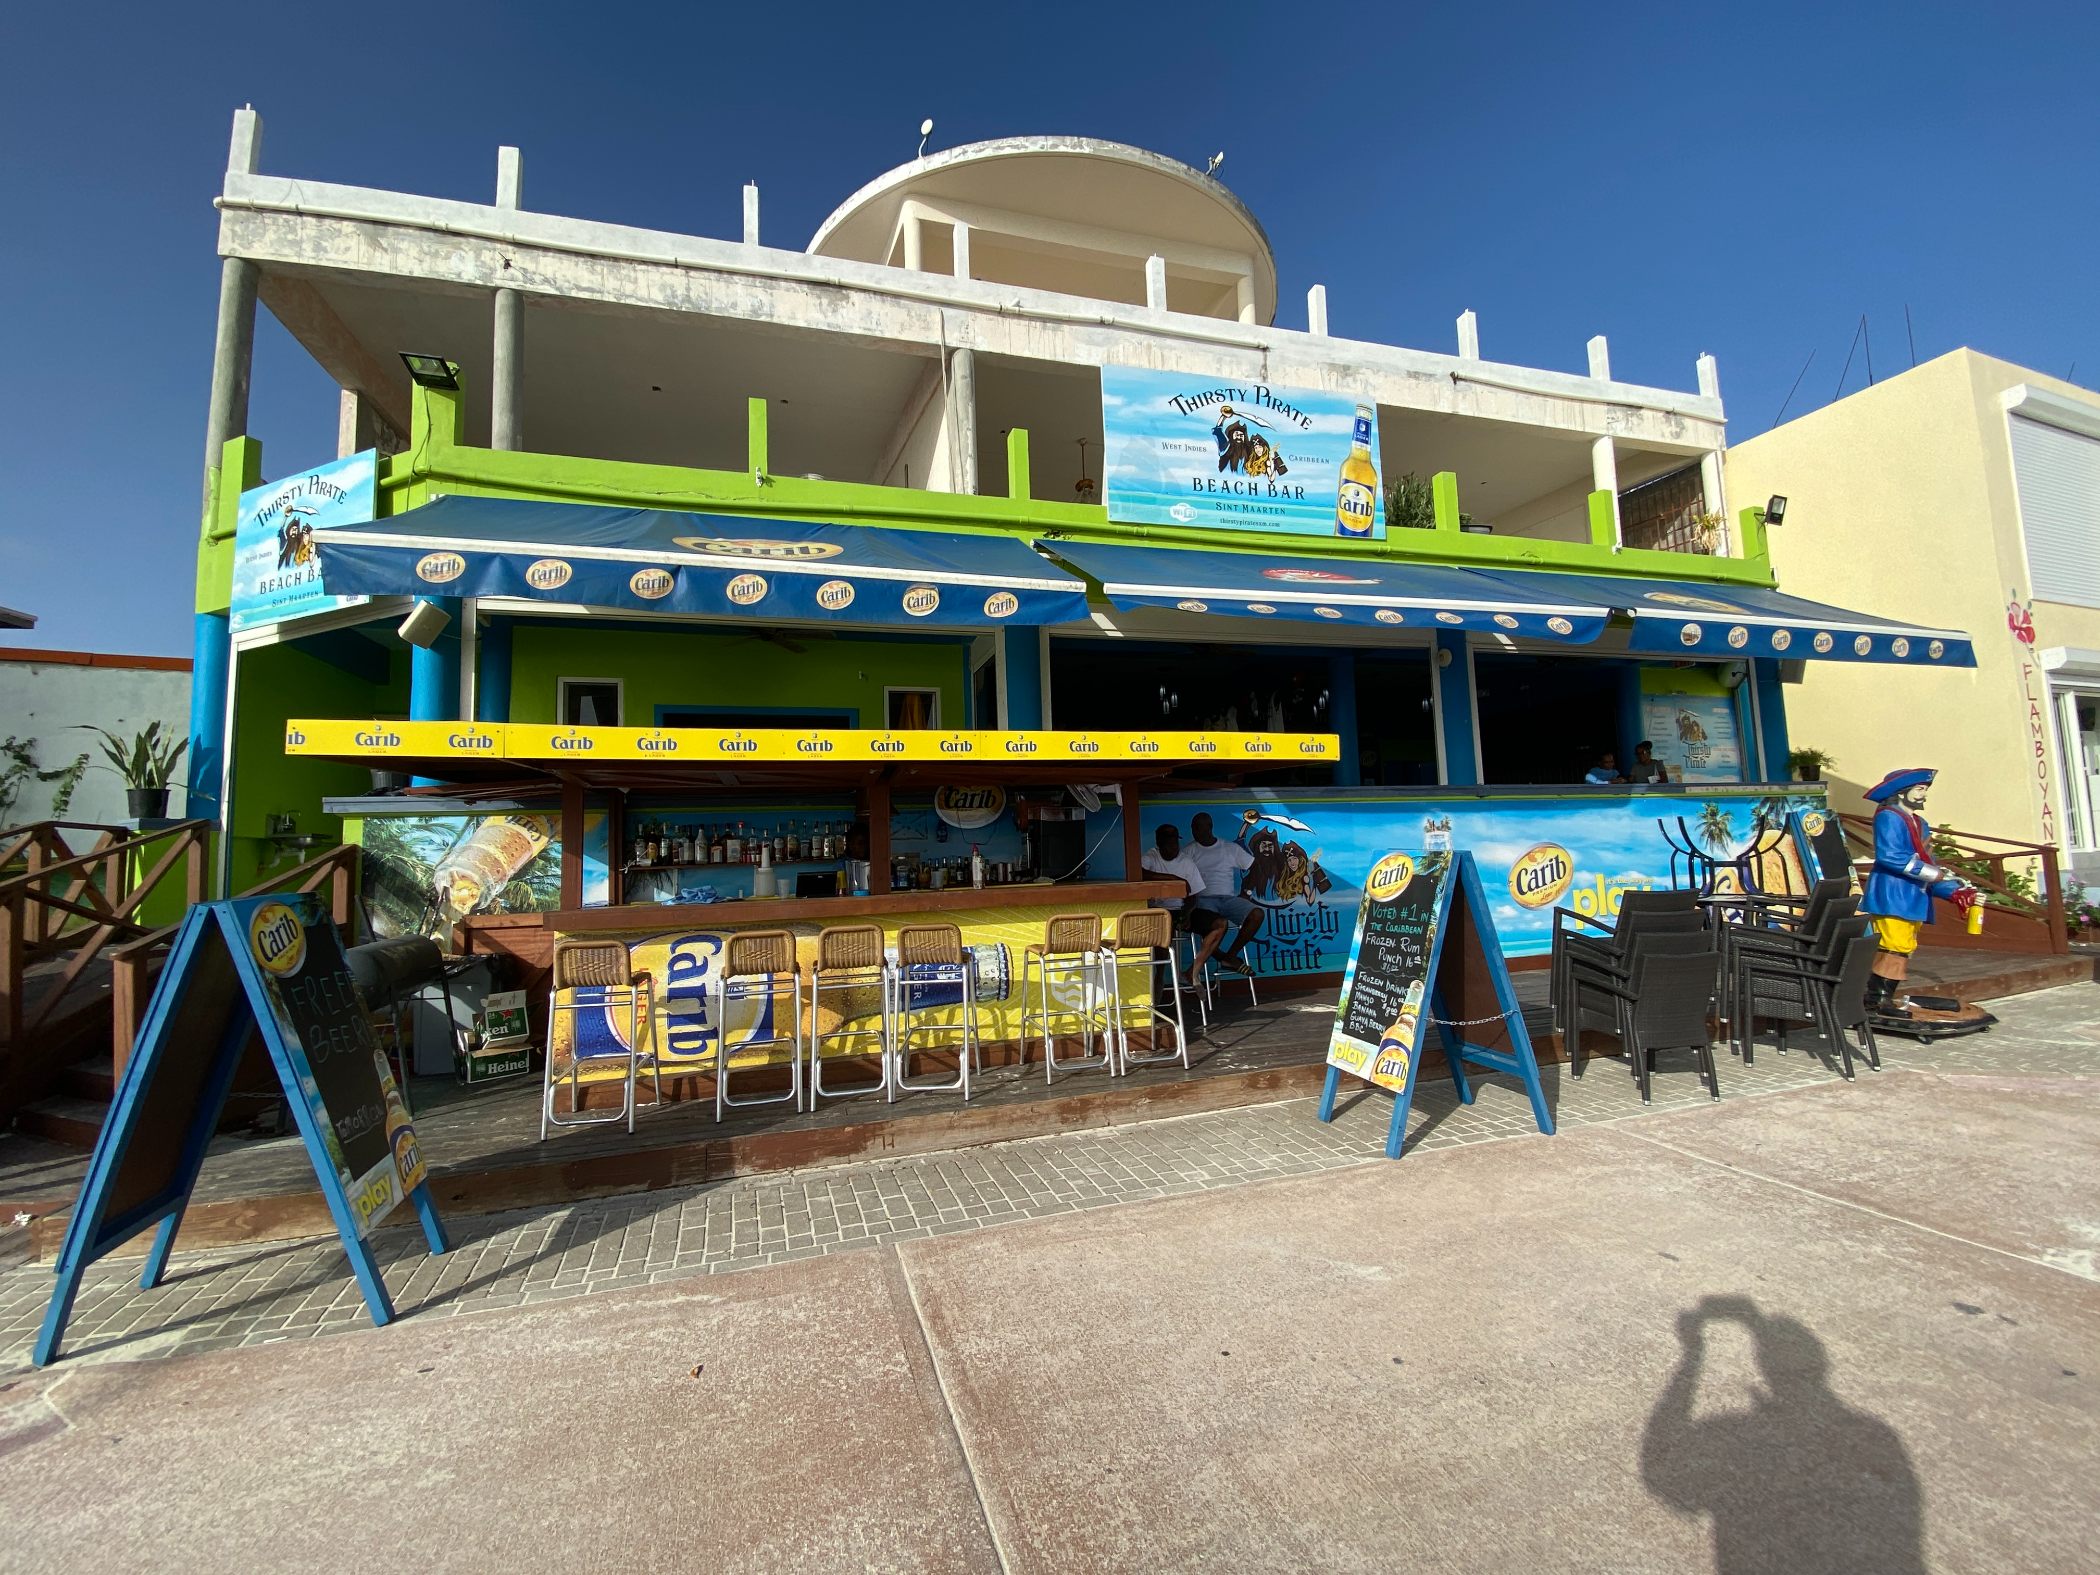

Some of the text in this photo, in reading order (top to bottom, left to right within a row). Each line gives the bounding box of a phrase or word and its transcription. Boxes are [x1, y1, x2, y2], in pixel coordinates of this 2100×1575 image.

[1169, 385, 1313, 430] THIRSTY PIRATE
[1161, 441, 1207, 453] WEST INDIES
[1288, 454, 1330, 465] CARIBBEAN
[1193, 477, 1305, 501] BEACH BAR
[253, 474, 347, 528] THIRSTY PIRATE
[1215, 501, 1286, 516] SINT MAARTEN
[1339, 494, 1373, 517] Carib
[421, 554, 461, 576] Carib
[531, 561, 569, 582] Carib
[260, 567, 323, 595] BEACH BA
[634, 574, 670, 590] Carib
[731, 578, 764, 598] Carib
[821, 585, 852, 602] Carib
[906, 592, 936, 608] Carib
[988, 596, 1016, 613] Carib
[355, 732, 401, 747] Carib
[449, 734, 493, 748] Carib
[551, 735, 593, 750] Carib
[637, 737, 678, 751] Carib
[719, 738, 758, 752] Carib
[796, 739, 833, 752] Carib
[870, 740, 905, 752] Carib
[940, 740, 973, 752] Carib
[1005, 740, 1037, 753] Carib
[1069, 740, 1099, 753] Carib
[1130, 741, 1159, 753] Carib
[1189, 741, 1216, 753] Carib
[1245, 741, 1272, 754] Carib
[1299, 741, 1325, 754] Carib
[2022, 663, 2057, 847] FLAMBOYAN
[1372, 862, 1409, 889] Carib
[1516, 854, 1567, 896] Carib
[1572, 874, 1651, 930] pla
[1250, 900, 1340, 944] Thirsty
[257, 912, 299, 963] Carib
[1249, 939, 1323, 973] Pirate
[667, 934, 723, 1056] Carib
[1333, 1039, 1368, 1072] play
[357, 1174, 393, 1228] play
